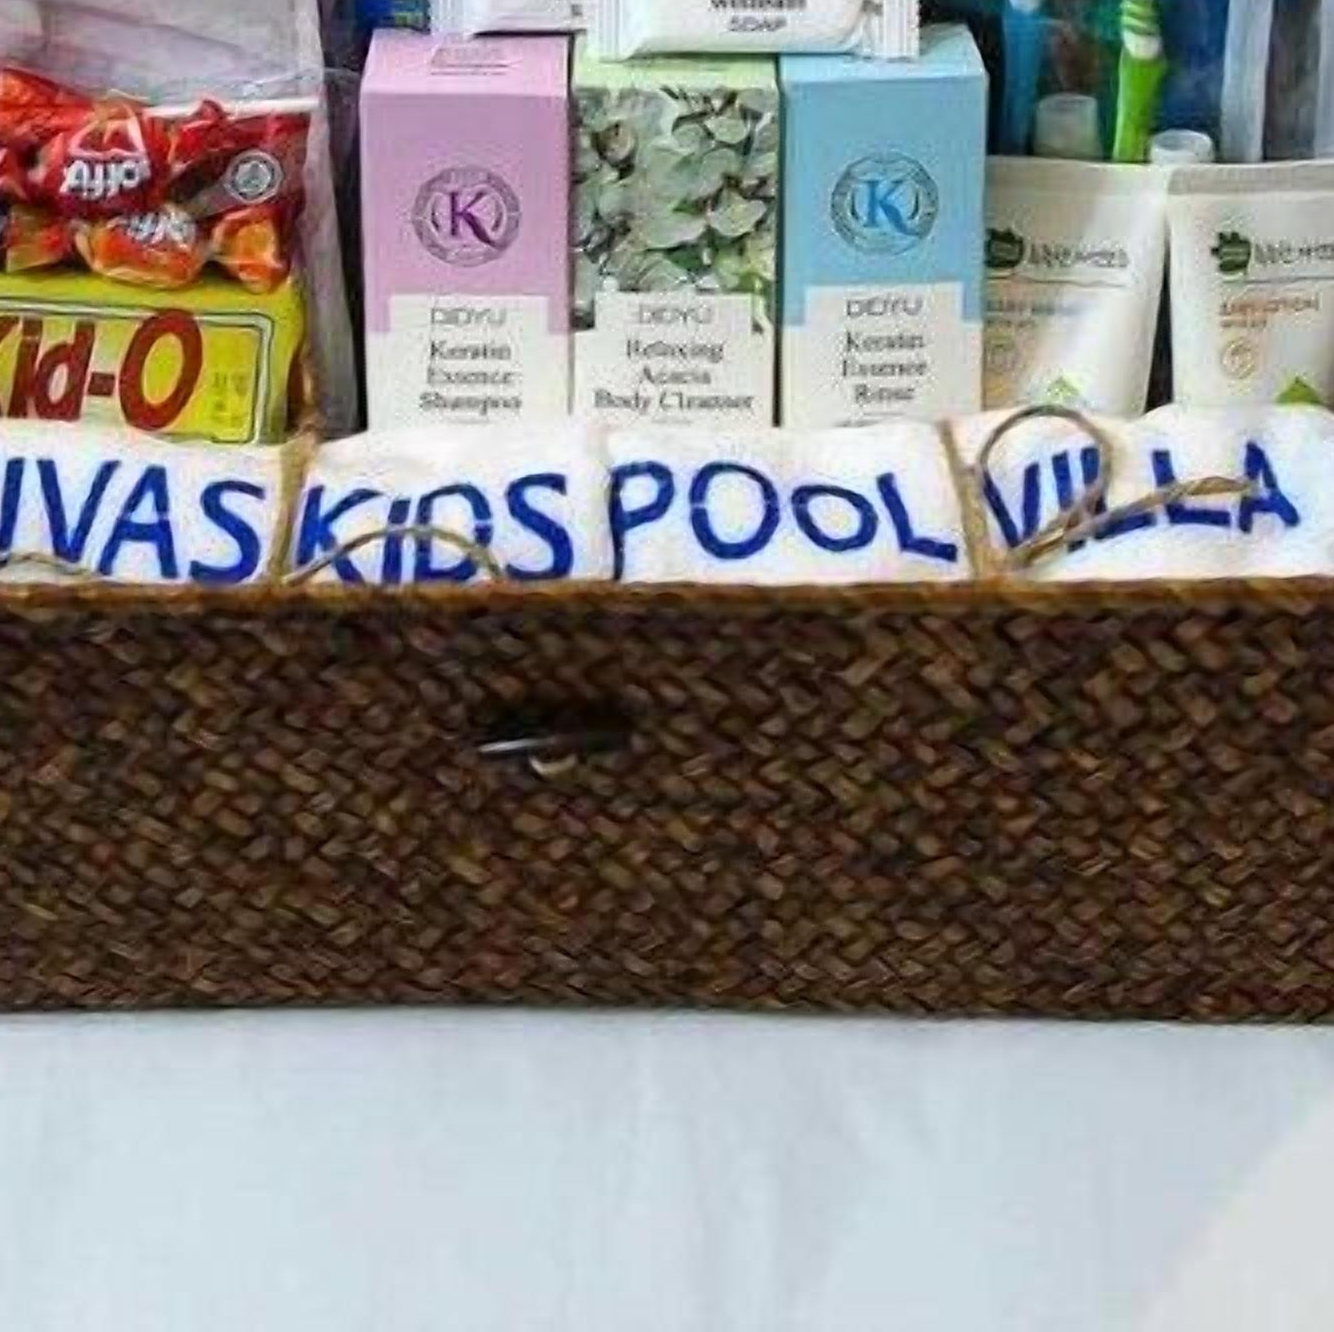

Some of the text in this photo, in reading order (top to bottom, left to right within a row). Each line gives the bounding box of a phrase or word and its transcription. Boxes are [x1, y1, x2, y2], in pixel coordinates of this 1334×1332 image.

[449, 190, 507, 253] K
[861, 178, 921, 236] K
[594, 389, 651, 415] Body
[295, 471, 575, 586] KIDS
[608, 459, 959, 582] POOL
[981, 441, 1300, 553] VILLA
